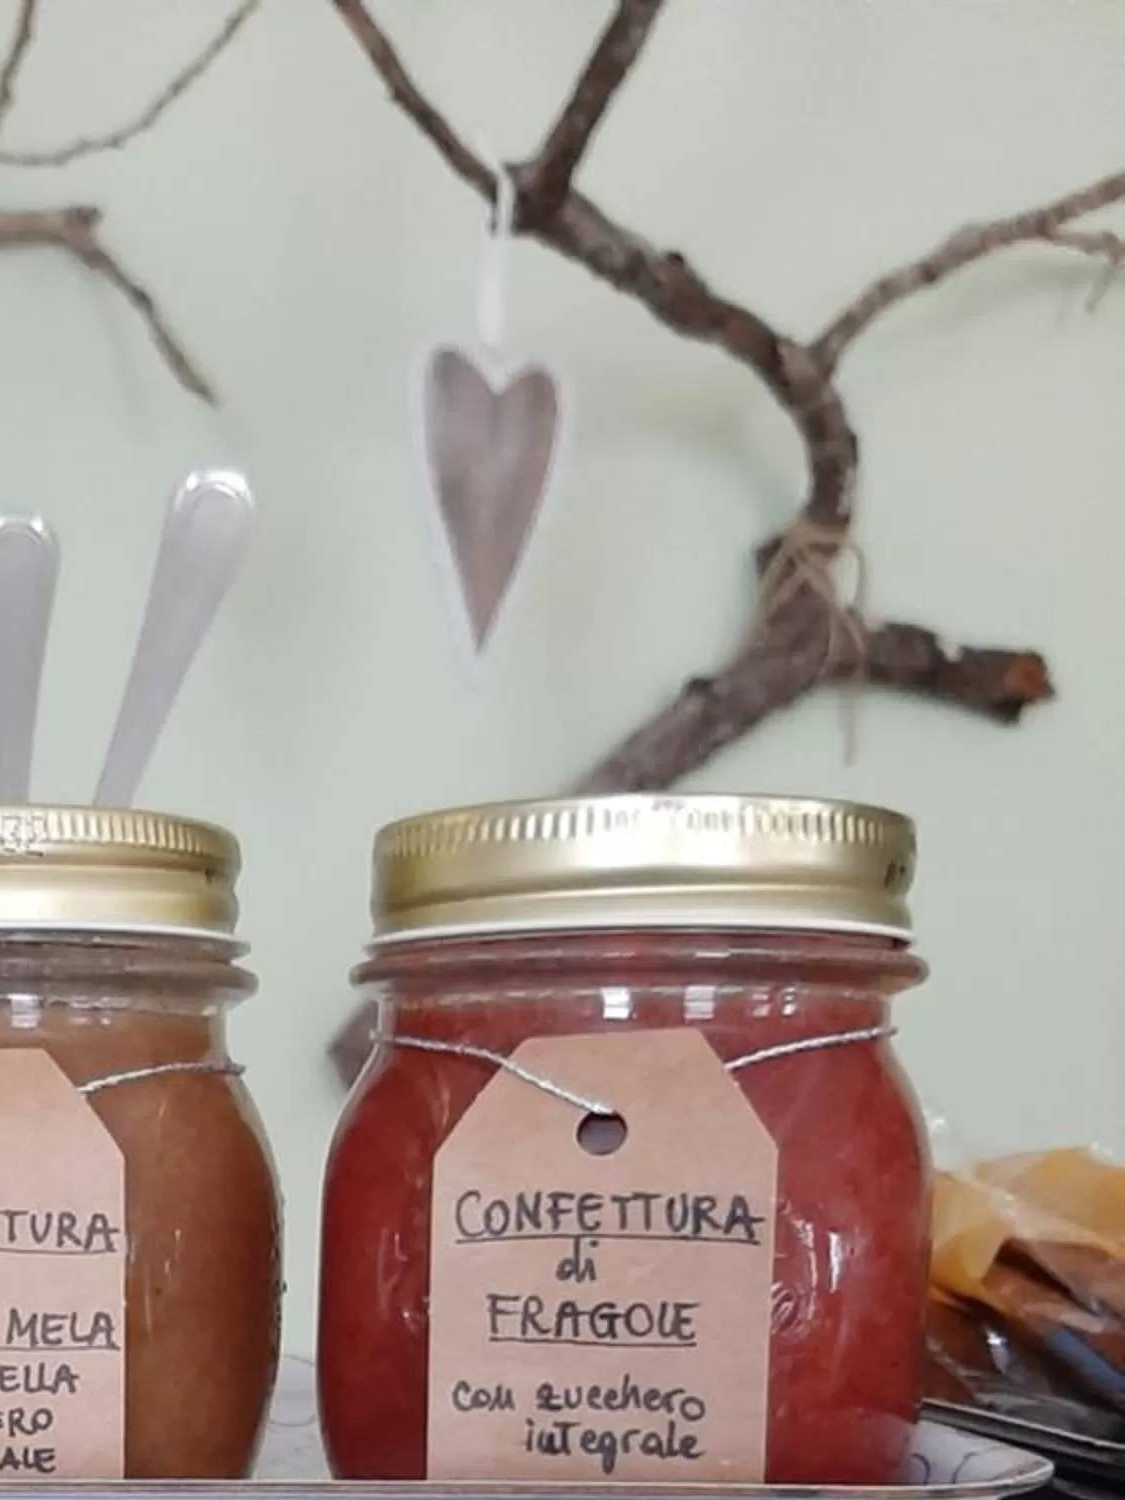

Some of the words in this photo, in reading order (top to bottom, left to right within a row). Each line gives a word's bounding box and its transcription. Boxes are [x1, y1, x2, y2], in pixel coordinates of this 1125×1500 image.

[455, 1190, 766, 1240] CONFETTURA
[555, 1236, 599, 1281] di
[6, 1308, 116, 1347] MELA
[486, 1293, 700, 1341] FRAGOLE
